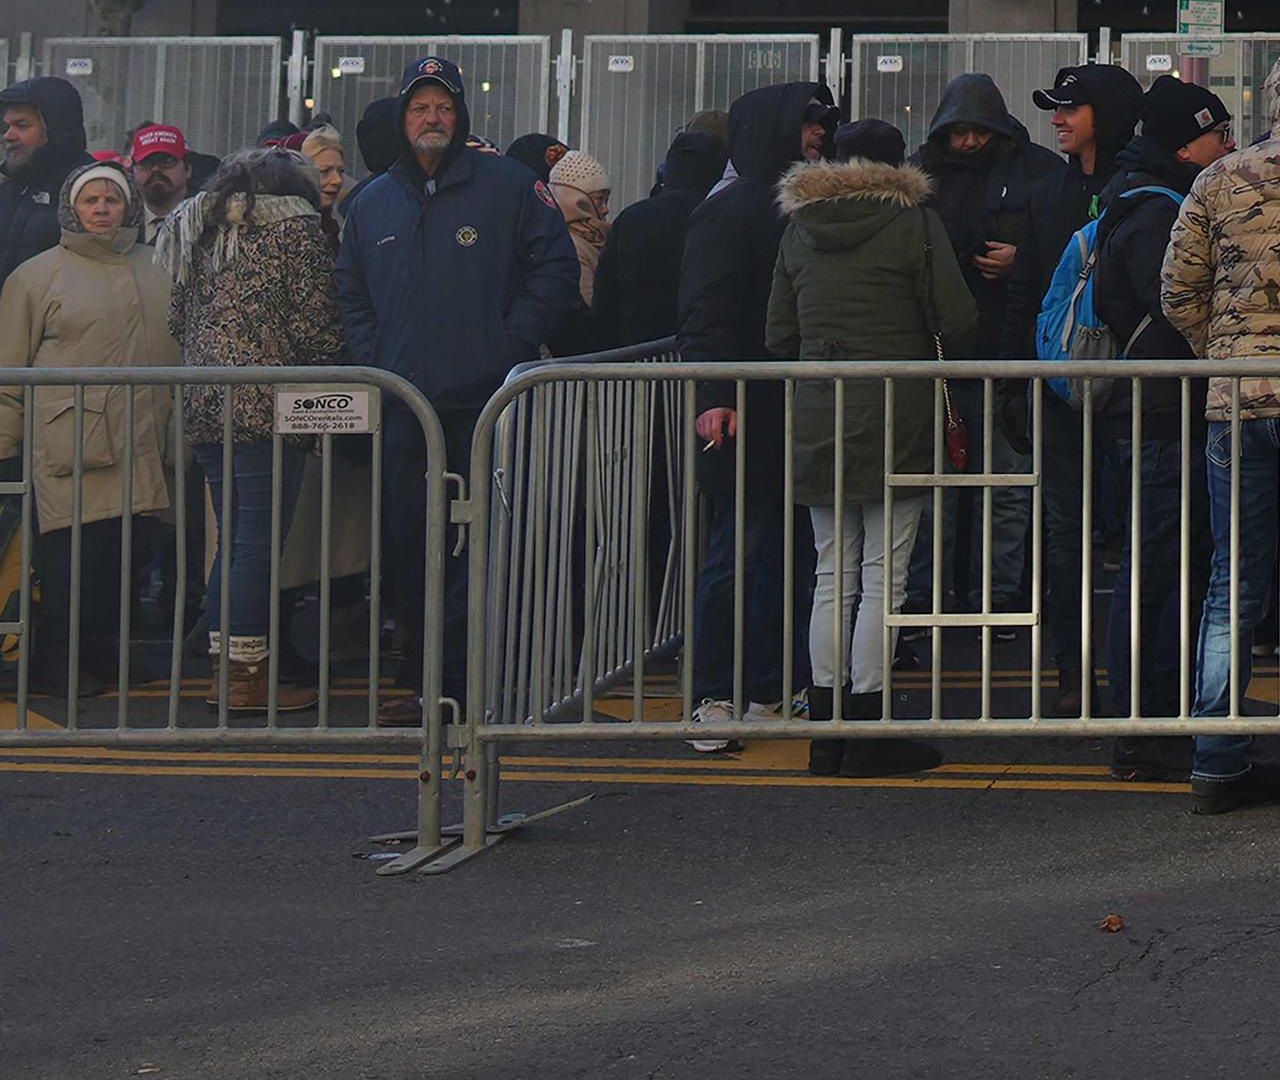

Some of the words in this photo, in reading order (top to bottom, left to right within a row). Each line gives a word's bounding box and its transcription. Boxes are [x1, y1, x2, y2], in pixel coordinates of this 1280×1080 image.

[293, 395, 352, 409] SONCO
[284, 414, 363, 422] SONCOrentals.com
[291, 422, 355, 430] 888-766-2618
